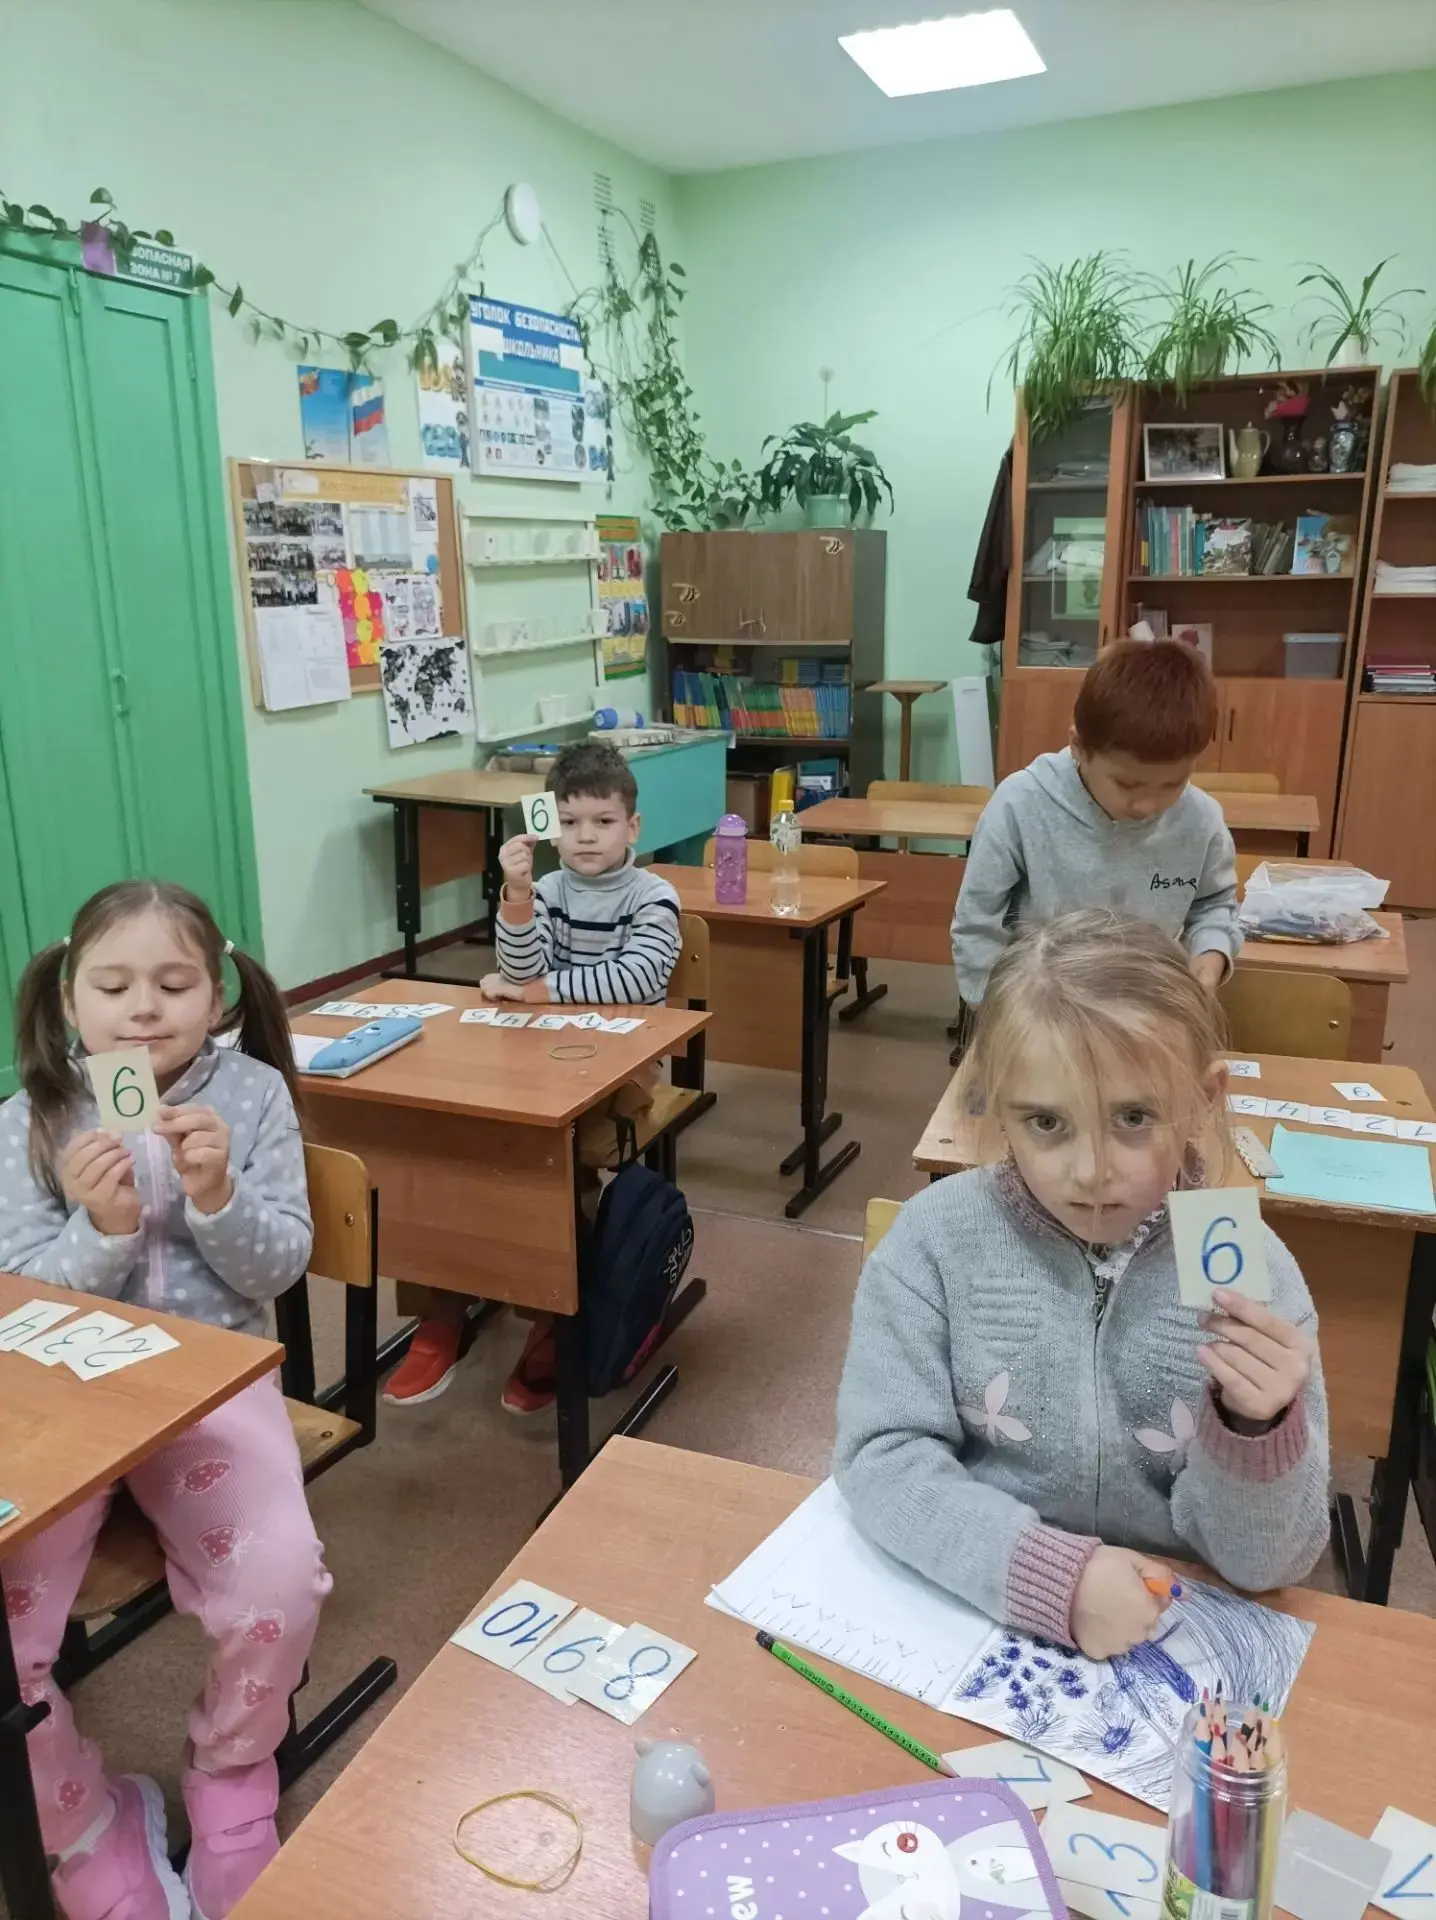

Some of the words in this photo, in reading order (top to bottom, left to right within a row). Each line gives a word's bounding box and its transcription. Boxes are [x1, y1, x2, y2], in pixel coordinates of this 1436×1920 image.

[470, 300, 512, 326] УГОЛОК
[531, 798, 549, 832] 6
[112, 1066, 145, 1118] 6
[1201, 1216, 1243, 1285] 6
[482, 1601, 558, 1647] 10
[604, 1646, 671, 1700] 8
[1069, 1833, 1158, 1883] 3
